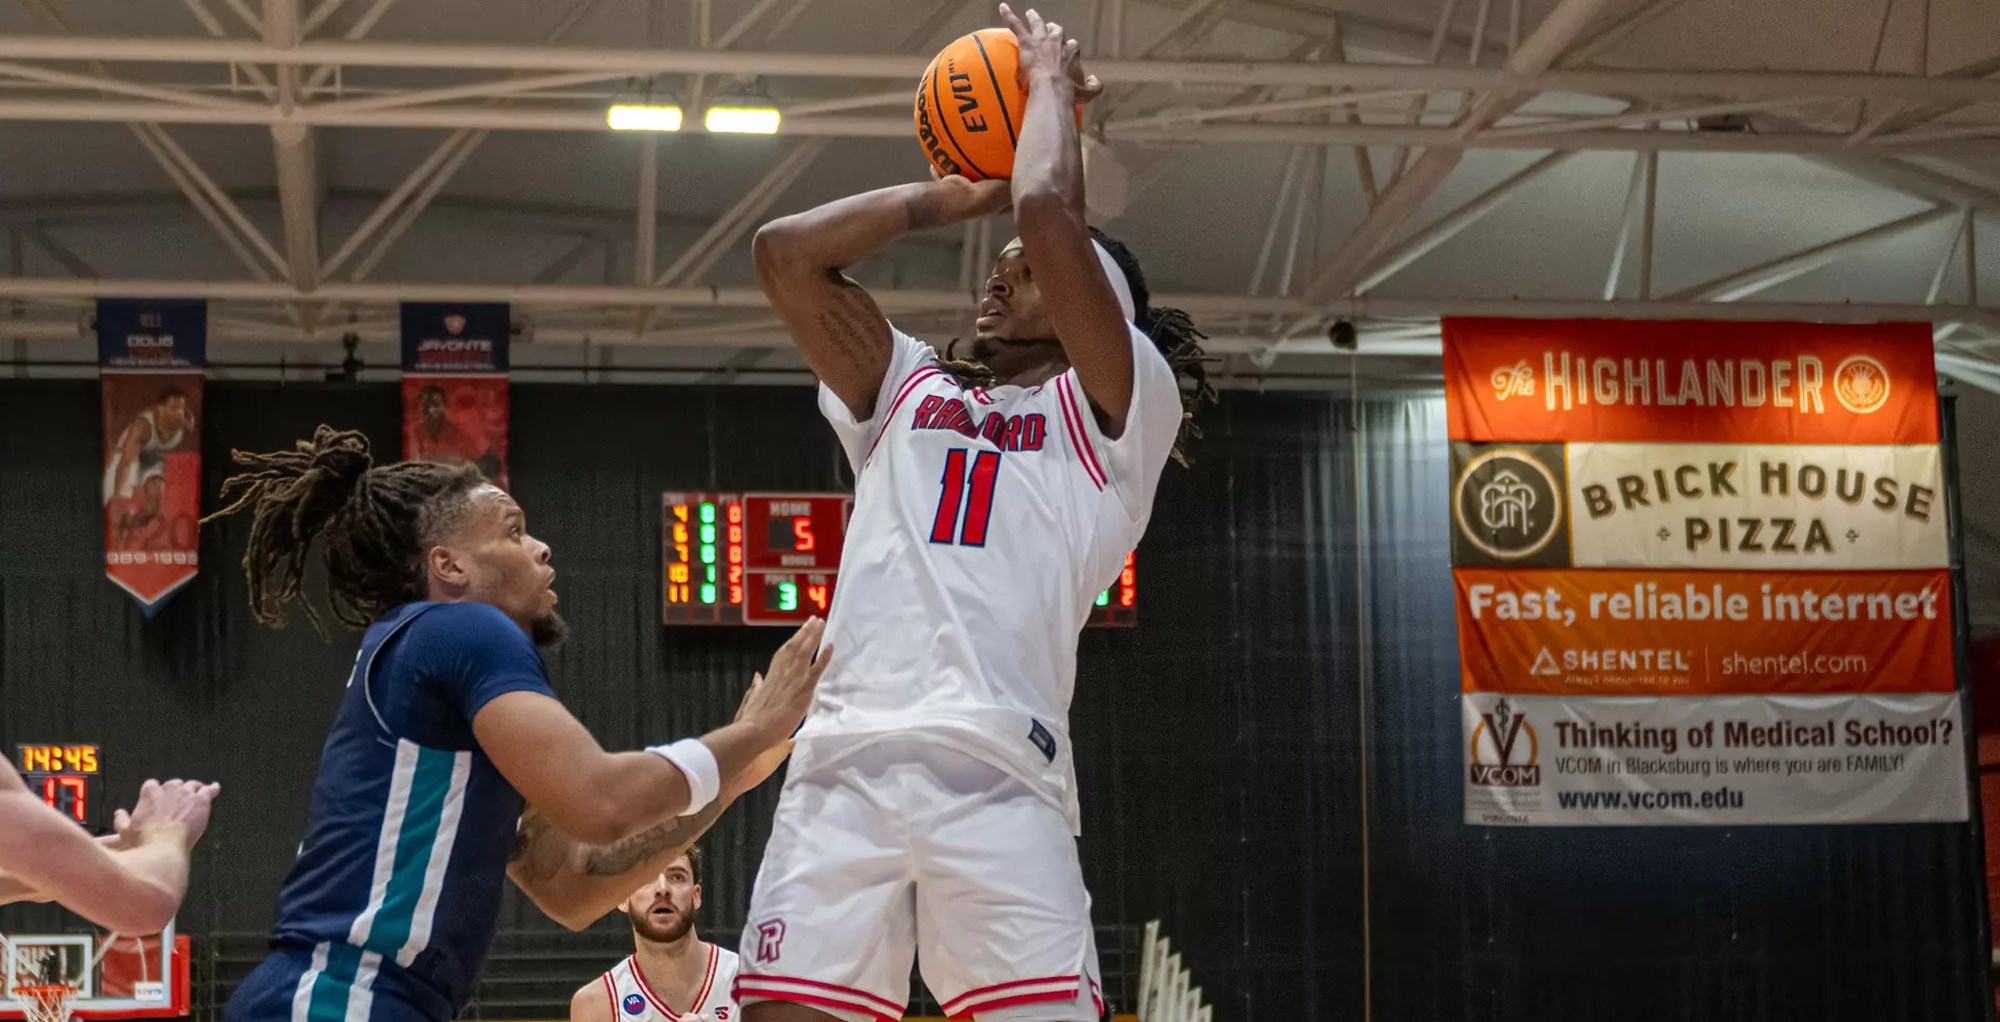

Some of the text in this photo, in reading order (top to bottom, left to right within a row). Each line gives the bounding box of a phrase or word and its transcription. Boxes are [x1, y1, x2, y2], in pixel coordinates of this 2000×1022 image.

[1490, 352, 1825, 414] The HIGHLANDER
[929, 448, 1002, 548] 11
[1581, 461, 1738, 520] BRICK
[1759, 460, 1936, 523] HOUSE
[769, 501, 811, 516] HOME
[793, 516, 816, 551] 5
[1684, 517, 1835, 553] PIZZA
[668, 563, 689, 583] 10
[728, 564, 742, 583] 2
[668, 583, 689, 603] 11
[778, 582, 798, 611] 3
[807, 584, 827, 610] 4
[1469, 583, 1937, 627] Fast, reliable internet
[1563, 648, 1690, 671] SHENTEL
[1721, 651, 1867, 674] shentel.com
[1553, 718, 1954, 754] Thinking of Medical School?
[23, 745, 98, 772] 14:45
[1555, 753, 1904, 778] VCOM in Blacksburg is where you are FAMILY!
[1473, 766, 1537, 785] VCOM
[43, 775, 87, 822] 17
[1558, 786, 1744, 809] www.vcom.edu
[756, 918, 786, 964] R
